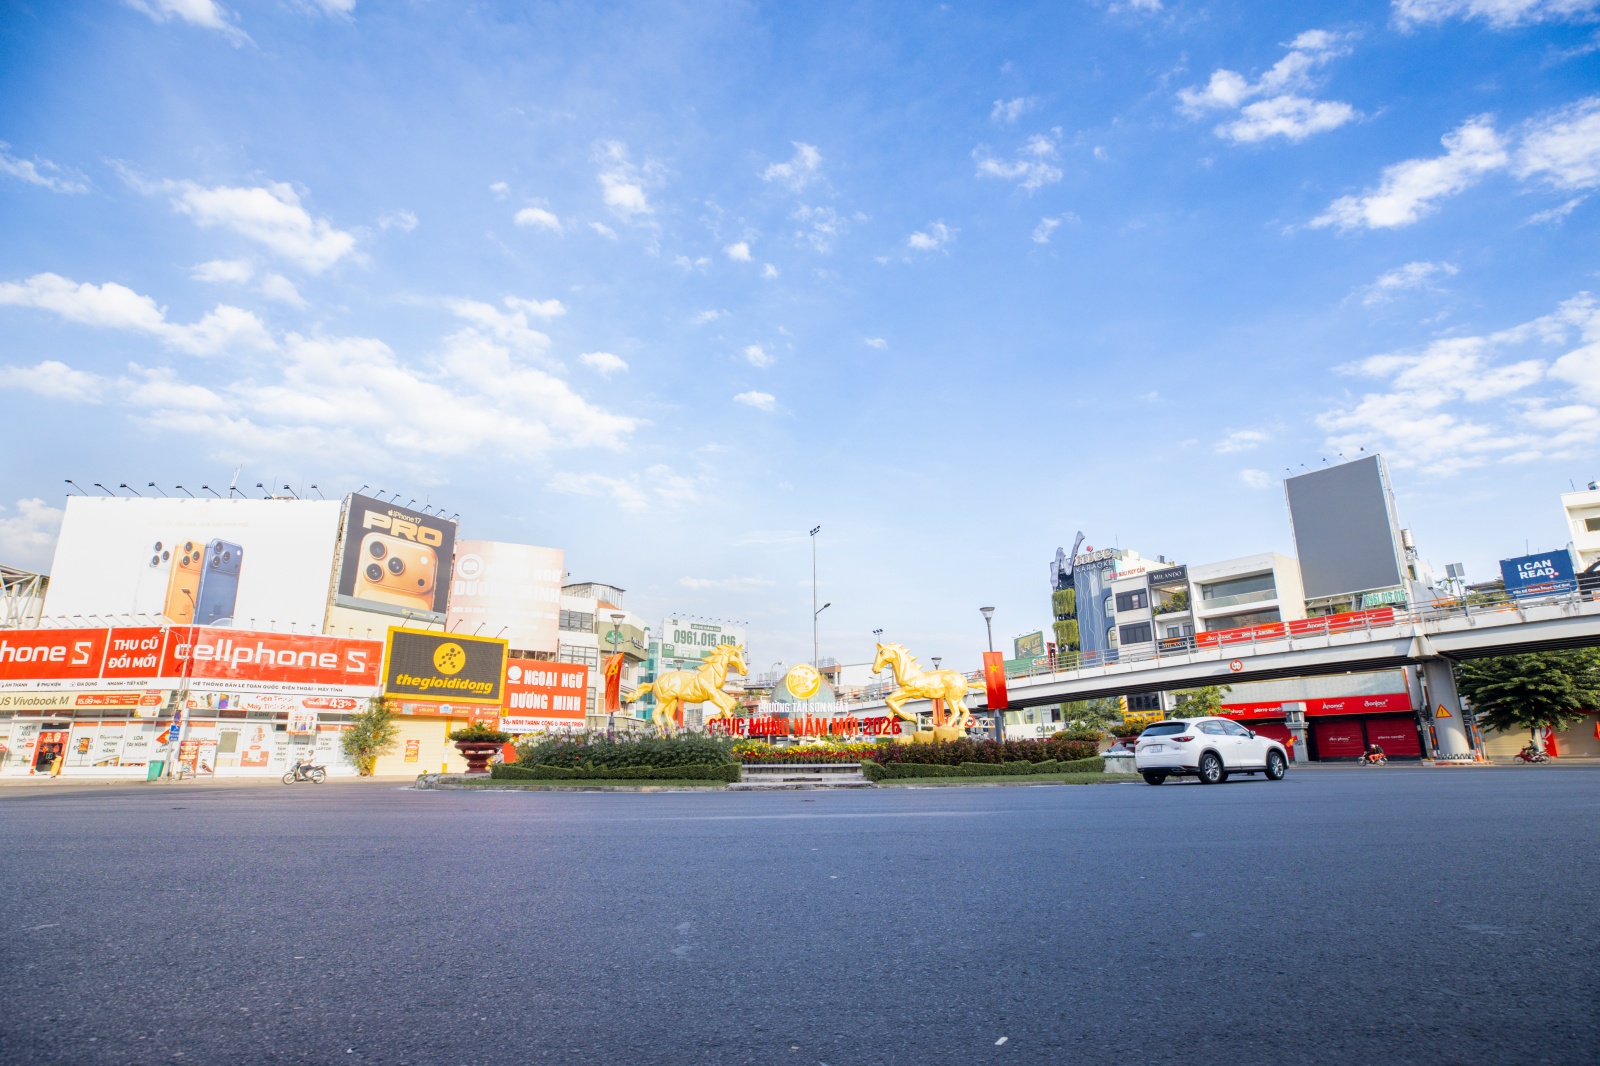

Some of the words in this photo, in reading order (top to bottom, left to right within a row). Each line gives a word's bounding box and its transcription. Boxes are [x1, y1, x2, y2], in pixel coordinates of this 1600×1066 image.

[392, 510, 415, 522] iPhone
[415, 516, 422, 524] 17
[362, 509, 443, 548] PRO
[1075, 559, 1114, 573] KARAOKE
[1517, 564, 1522, 572] I
[1523, 559, 1552, 571] CAN
[1153, 570, 1182, 581] MILANDO
[113, 639, 140, 651] THU
[141, 636, 159, 651] CŨ
[674, 629, 736, 648] 0961.015.016
[107, 653, 131, 669] ĐỔI
[132, 653, 157, 668] MỚI
[395, 673, 494, 695] thegioididong
[523, 669, 558, 690] NGOẠI
[561, 671, 585, 689] NGỮ
[13, 696, 58, 706] Vivobook
[58, 696, 70, 705] M
[329, 699, 352, 709] 43%
[510, 691, 549, 710] DƯƠNG
[552, 694, 581, 711] MINH
[758, 700, 791, 713] PHƯỜNG
[792, 701, 808, 713] TÂN
[808, 701, 824, 713] SƠN
[824, 700, 849, 713] NHẤT
[748, 714, 791, 736] MỪNG
[793, 714, 830, 736] NĂM
[831, 713, 859, 736] MỚI
[863, 716, 901, 736] 2026
